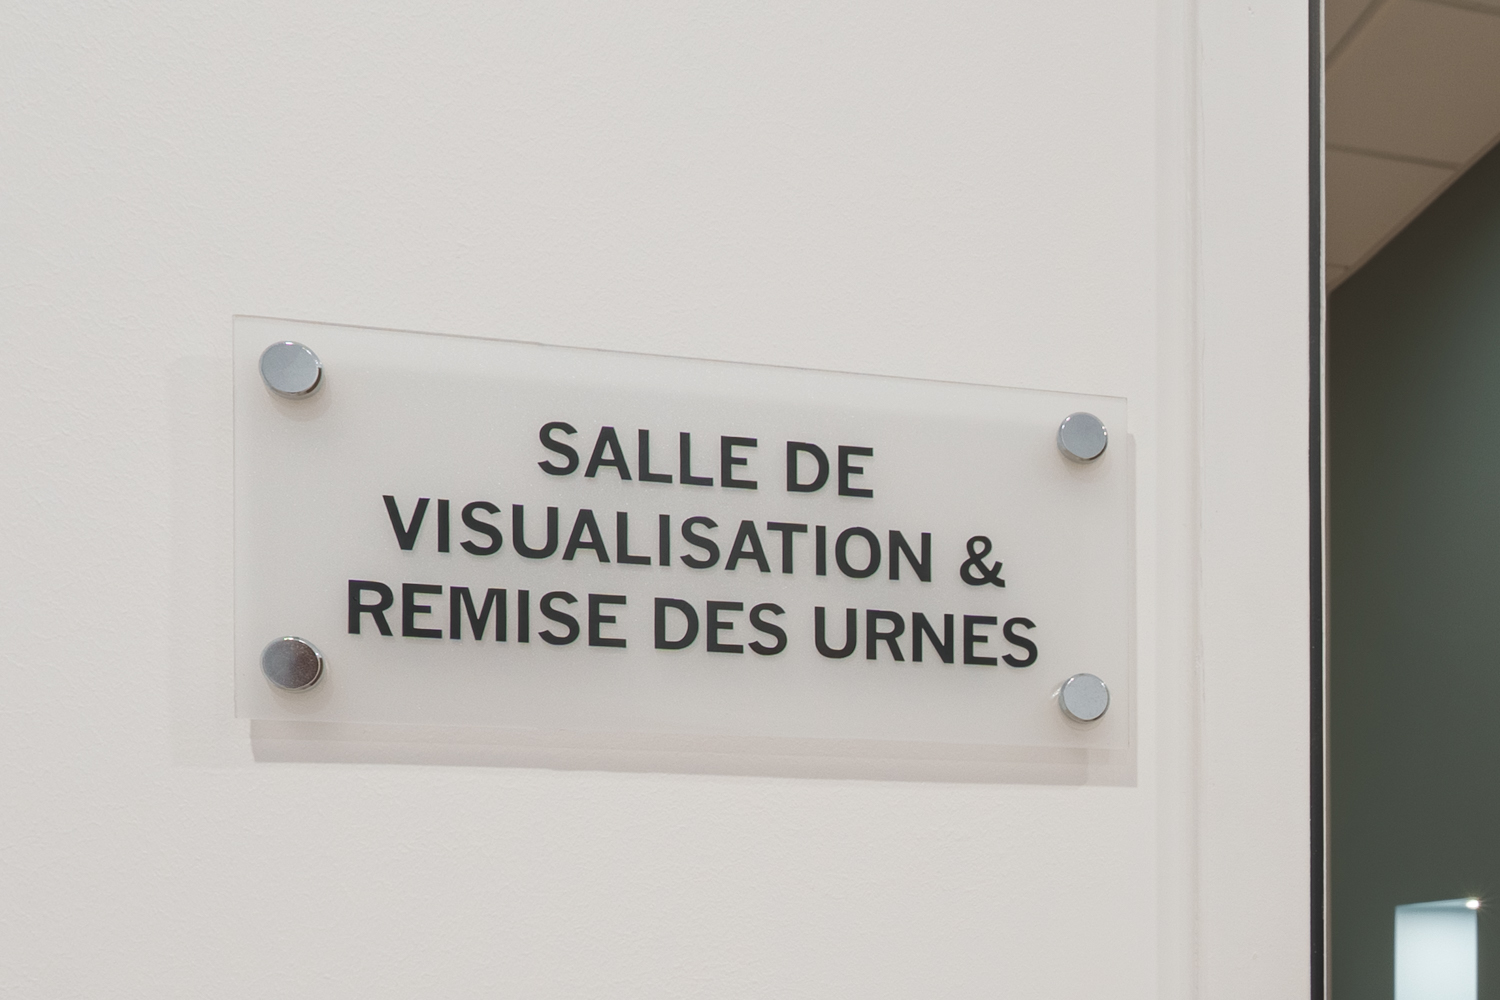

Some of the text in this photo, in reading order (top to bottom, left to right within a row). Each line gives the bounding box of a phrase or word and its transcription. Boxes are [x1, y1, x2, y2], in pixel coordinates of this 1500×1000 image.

[537, 421, 874, 499] SALLE DE
[382, 494, 1006, 588] VISUALISATION &
[347, 579, 1038, 669] REMISE DES URNES
